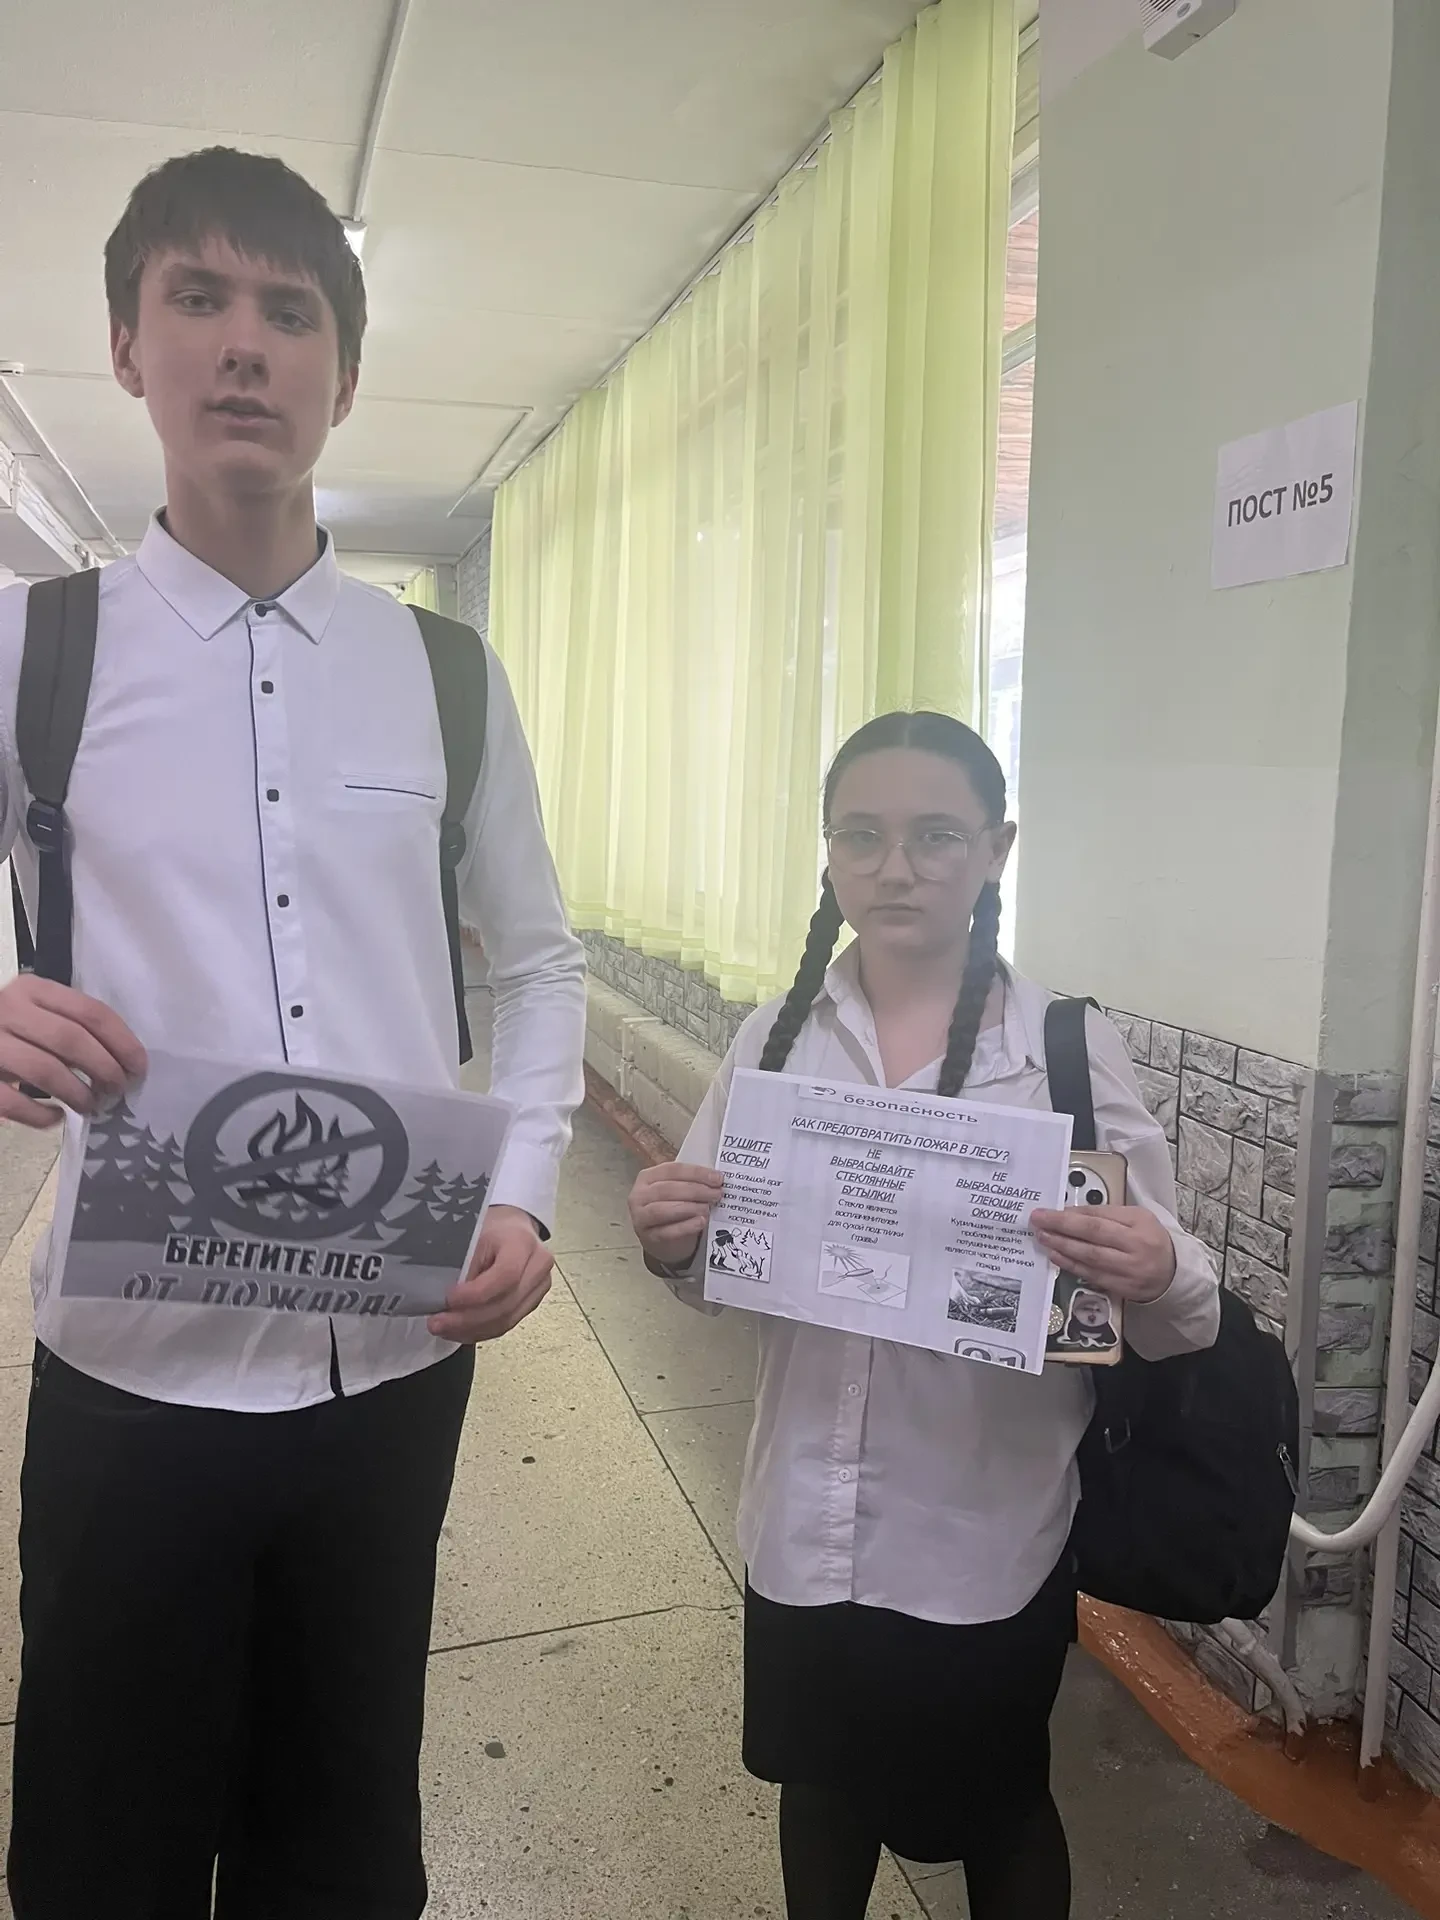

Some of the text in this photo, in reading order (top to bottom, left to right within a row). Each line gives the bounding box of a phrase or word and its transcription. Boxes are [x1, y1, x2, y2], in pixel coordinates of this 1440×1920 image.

[1228, 473, 1334, 527] ПОСТ №5
[844, 1094, 978, 1123] безопасность
[723, 1135, 773, 1153] ТУШИТЕ
[791, 1116, 1010, 1161] КАК ПРЕДОТВРАТИТЬ ПОЖАР В ЛЕСУ?
[720, 1151, 770, 1169] КОСТРЫ!
[866, 1148, 882, 1160] НЕ
[830, 1155, 916, 1179] ВЫБРАСЫВАЙТЕ
[992, 1171, 1008, 1182] НЕ
[835, 1170, 906, 1191] СТЕКЛЯННЫЕ
[956, 1178, 1042, 1201] ВЫБРАСЫВАЙТЕ
[841, 1184, 896, 1203] БУТЫЛКИ!
[969, 1193, 1024, 1212] ТЛЕЮЩИЕ
[838, 1198, 864, 1209] Стекло
[827, 1219, 842, 1227] для
[842, 1221, 864, 1231] сухой
[971, 1207, 1018, 1224] ОКУРКИ!
[165, 1234, 385, 1282] БЕРЕГИТЕ ЛЕС
[1000, 1246, 1024, 1255] окурки
[121, 1271, 181, 1301] ОТ
